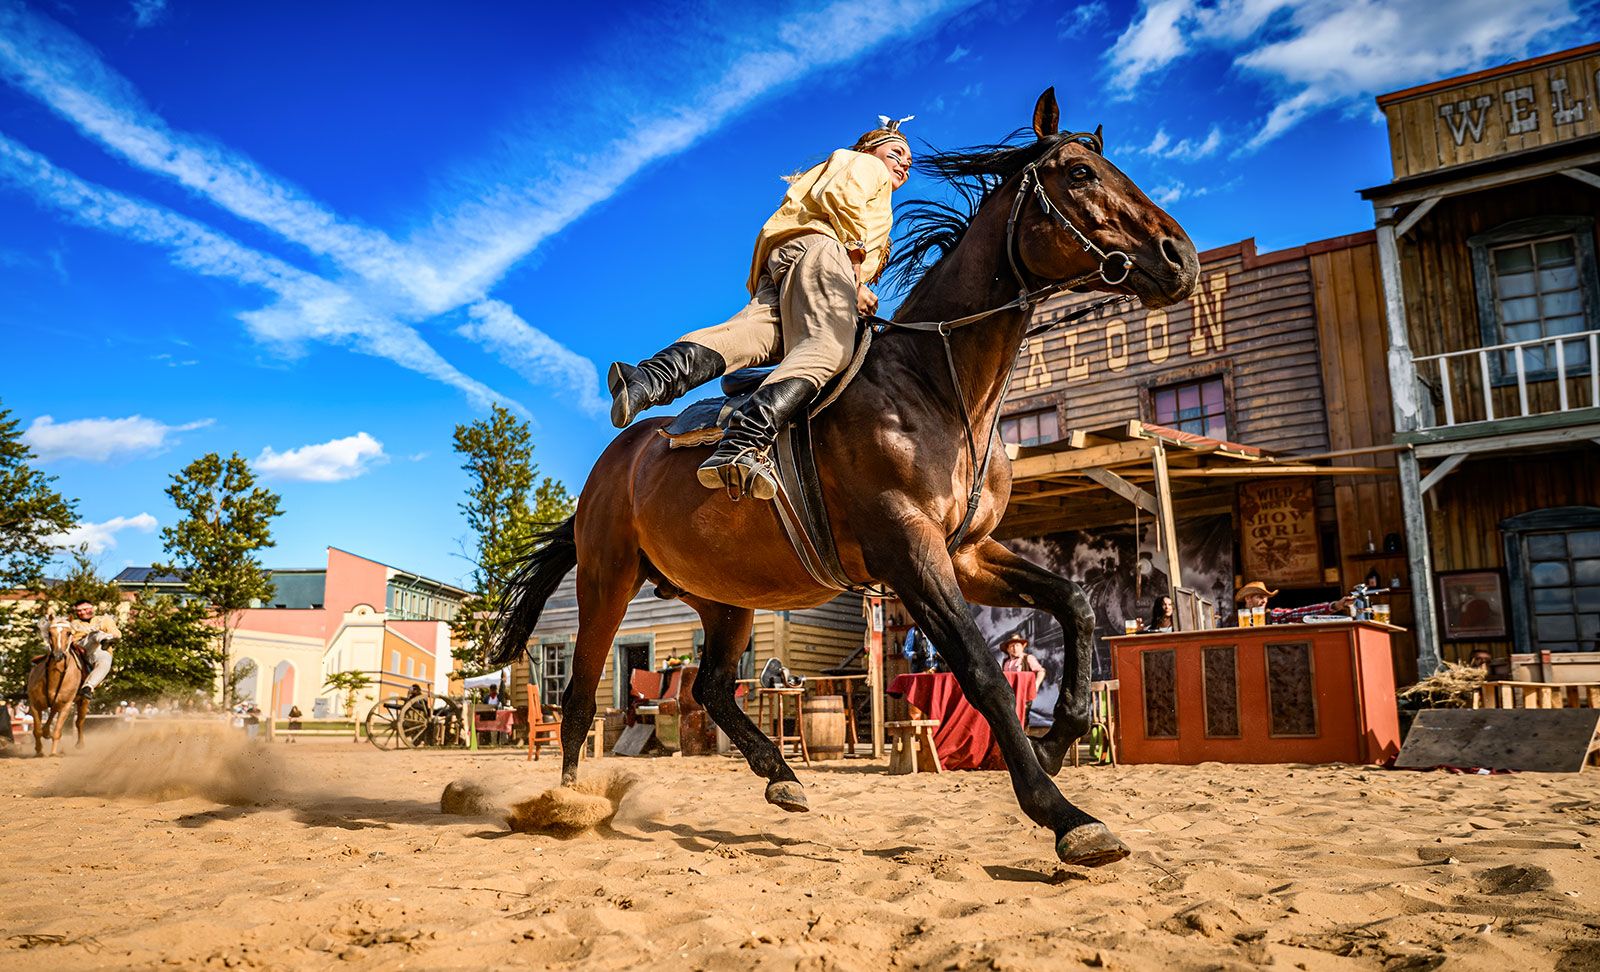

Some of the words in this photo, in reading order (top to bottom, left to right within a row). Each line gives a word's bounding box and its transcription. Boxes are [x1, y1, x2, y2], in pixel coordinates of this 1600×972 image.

[1439, 69, 1600, 146] WEL
[1023, 271, 1228, 392] ALOON
[1257, 487, 1293, 501] WILD
[1246, 511, 1307, 526] SHOW
